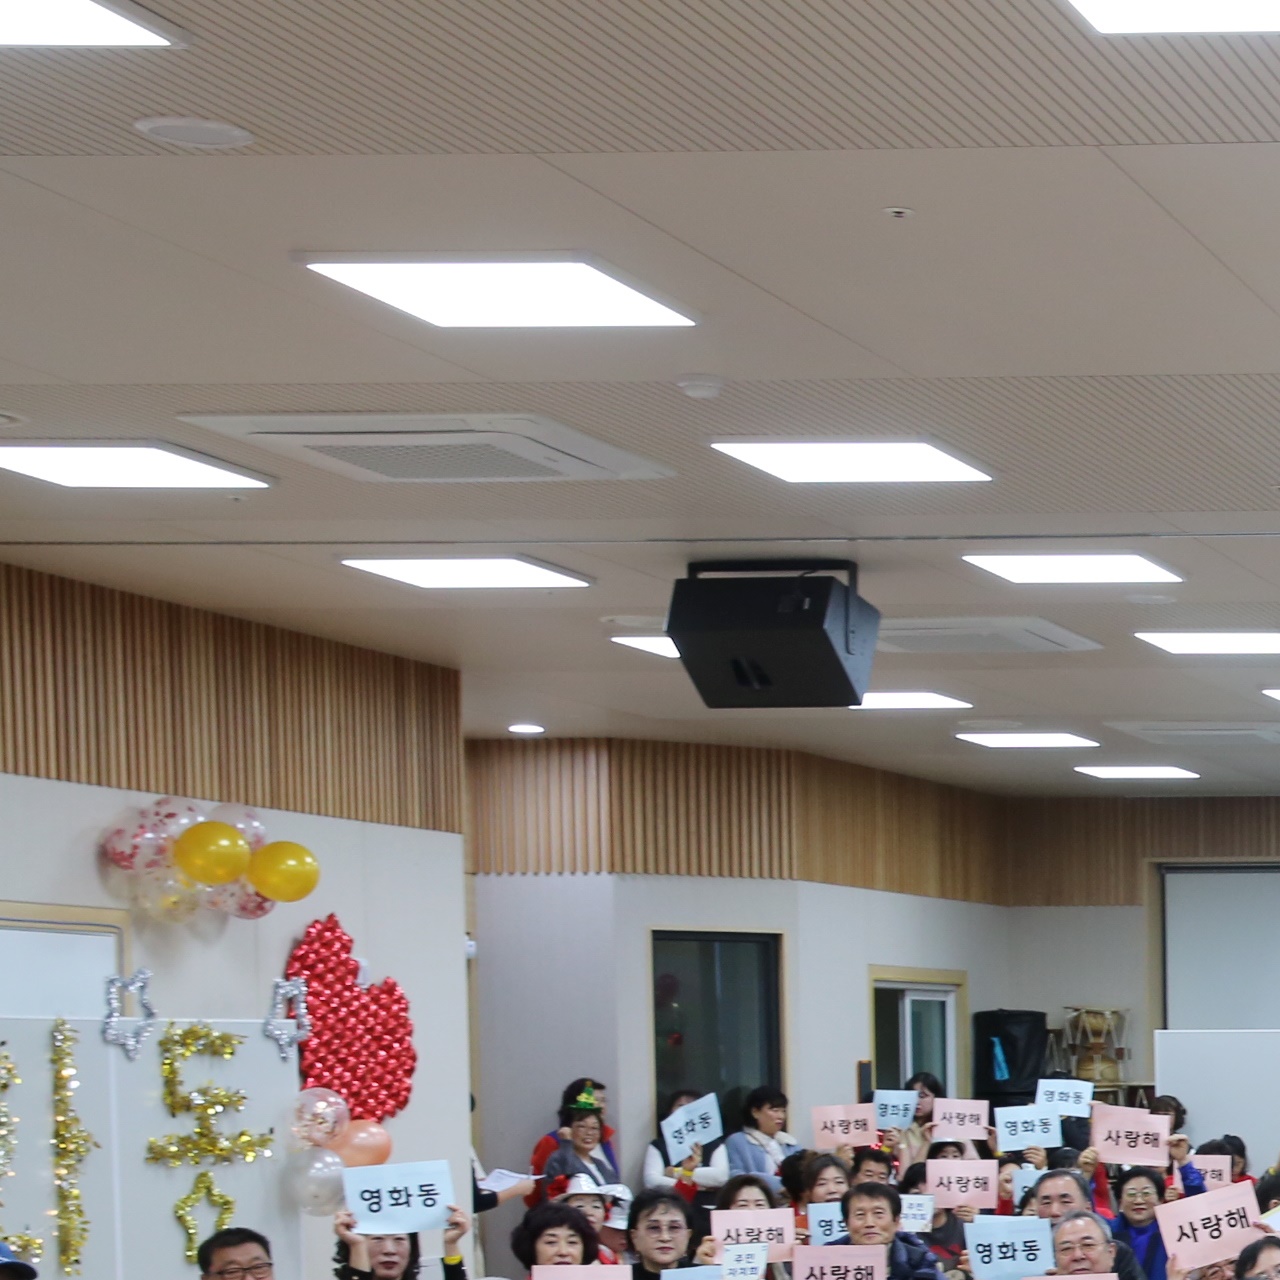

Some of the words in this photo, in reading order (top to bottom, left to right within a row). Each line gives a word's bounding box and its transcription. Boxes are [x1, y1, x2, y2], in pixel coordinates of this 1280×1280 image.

[1044, 1090, 1083, 1104] 영화동
[879, 1104, 910, 1117] 영화동
[672, 1113, 711, 1143] 영화동
[821, 1119, 868, 1134] 사랑해
[941, 1113, 980, 1126] 사랑해
[1005, 1118, 1051, 1136] 영화동
[1104, 1131, 1159, 1148] 사랑해
[936, 1177, 989, 1193] 사랑해
[360, 1184, 438, 1213] 영화동
[1177, 1207, 1250, 1242] 사랑해
[976, 1240, 1040, 1264] 영화동
